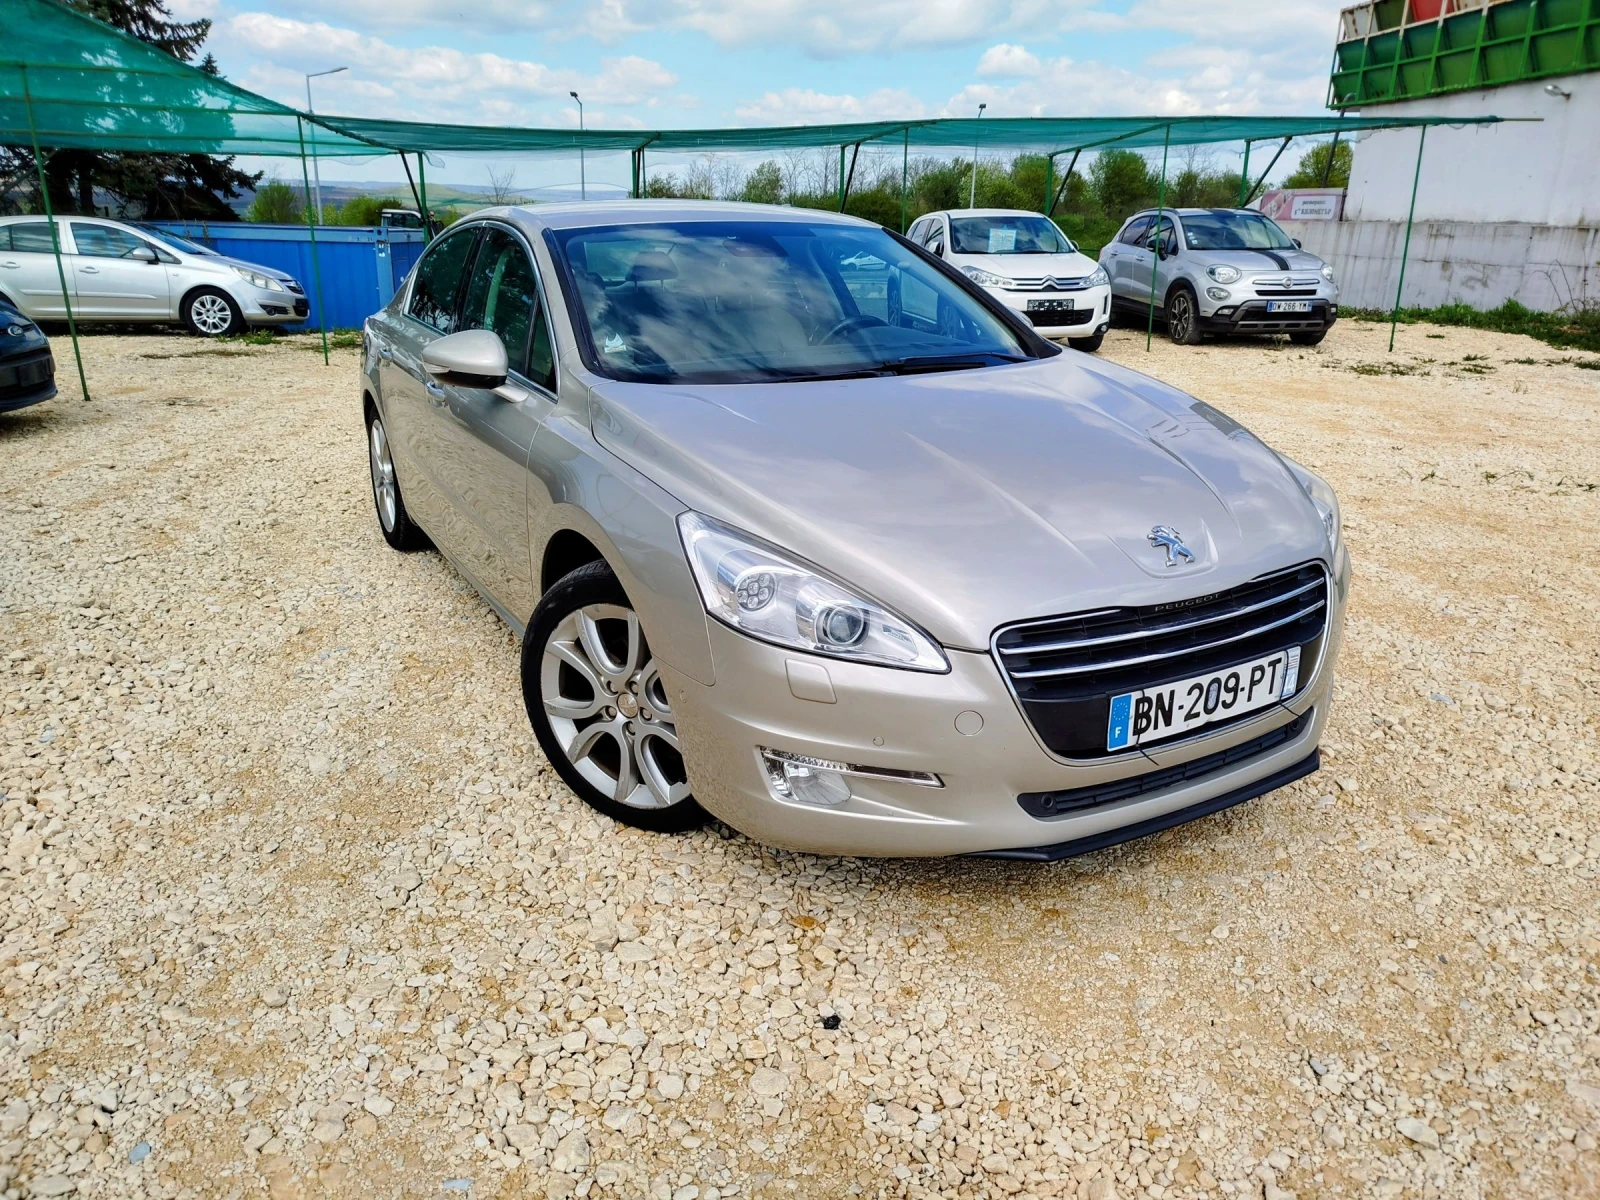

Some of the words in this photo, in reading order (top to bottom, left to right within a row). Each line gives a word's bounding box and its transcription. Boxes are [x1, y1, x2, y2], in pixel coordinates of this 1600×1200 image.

[1154, 593, 1222, 612] PEUGEOT
[1132, 657, 1282, 736] BN-209-PT
[1114, 726, 1121, 739] F
